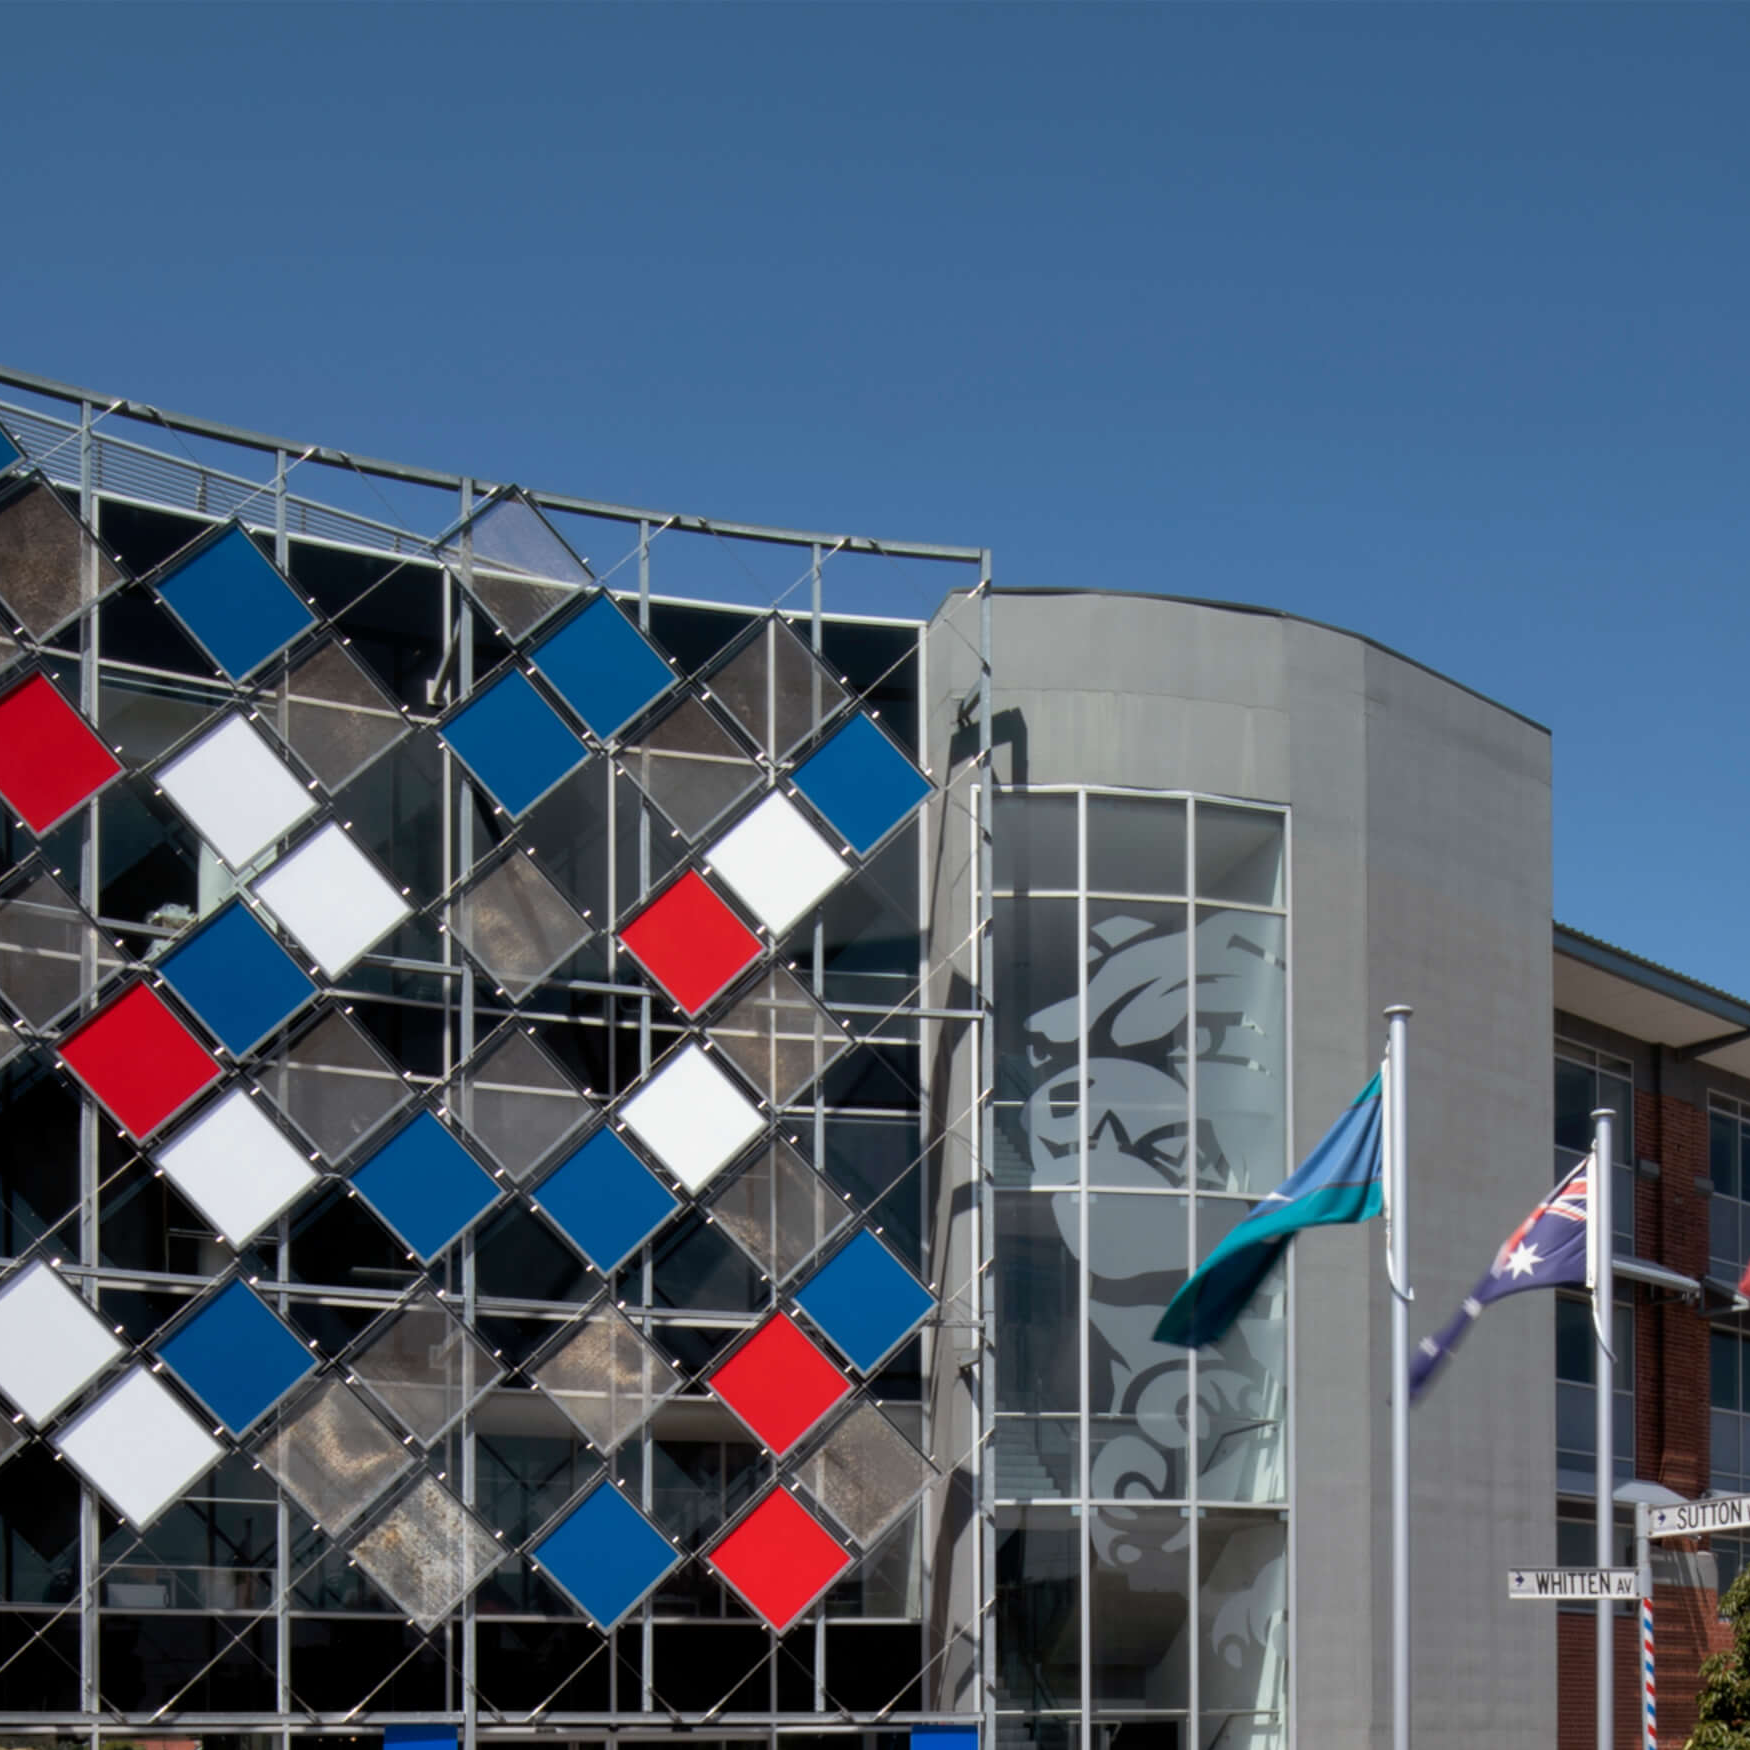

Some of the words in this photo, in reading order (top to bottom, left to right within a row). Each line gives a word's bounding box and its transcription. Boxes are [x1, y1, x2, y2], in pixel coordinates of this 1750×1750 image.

[1677, 1499, 1742, 1530] SUTTON
[1536, 1572, 1611, 1595] WHITTEN
[1616, 1578, 1633, 1593] AV
